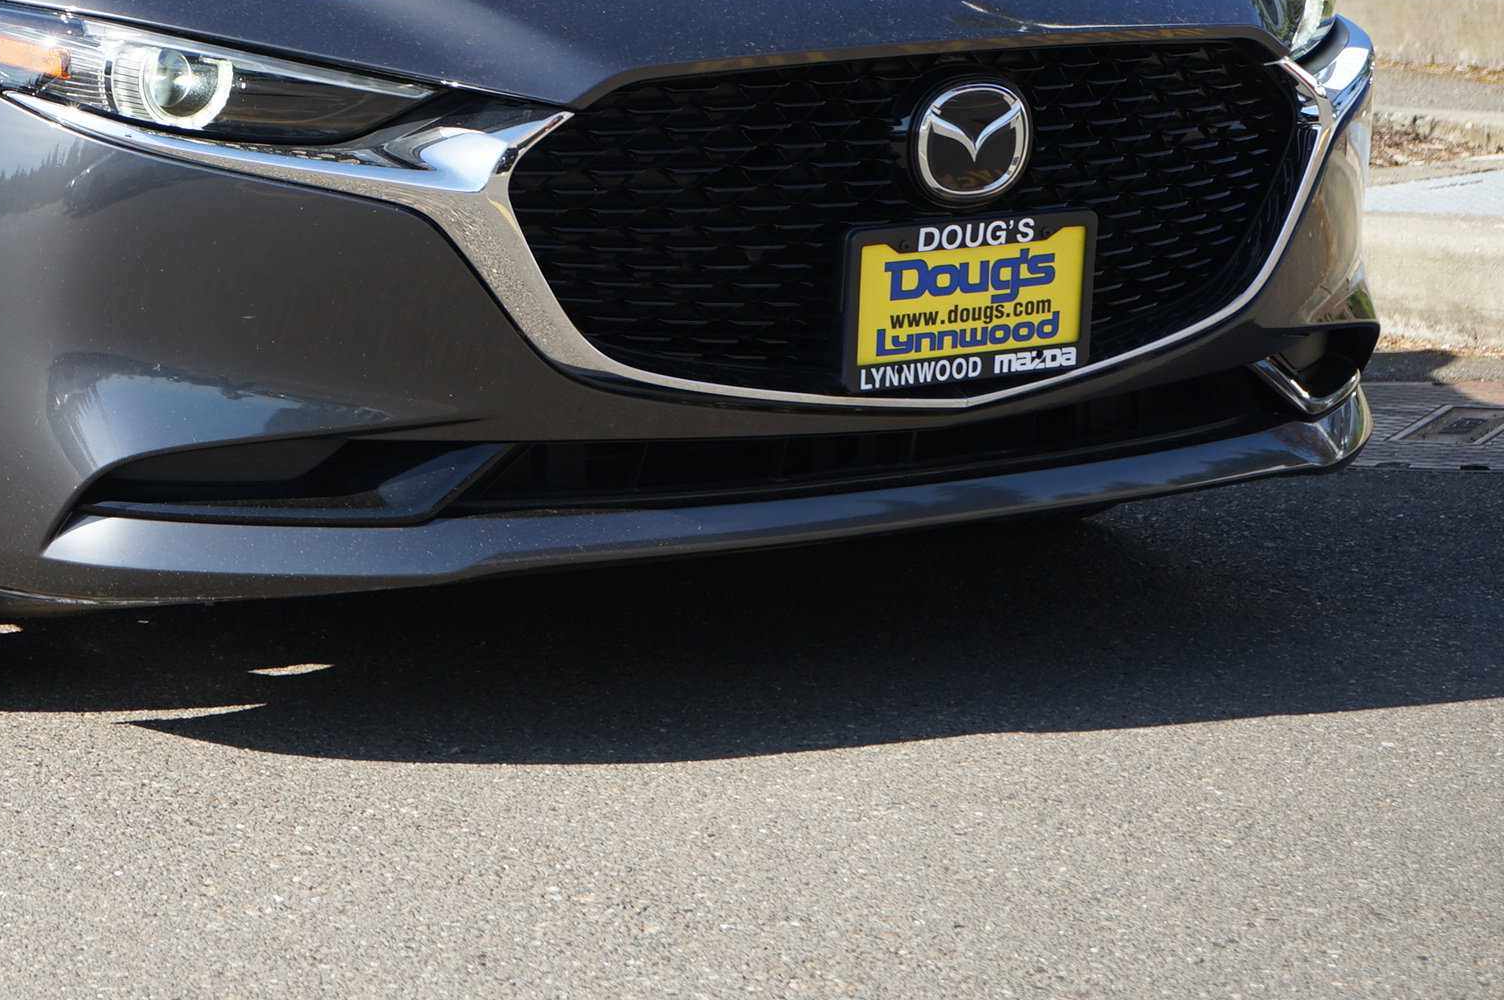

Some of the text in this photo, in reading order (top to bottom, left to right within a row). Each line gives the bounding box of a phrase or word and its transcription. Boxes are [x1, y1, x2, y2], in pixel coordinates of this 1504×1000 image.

[918, 217, 1036, 252] DOUG'S
[884, 248, 1056, 304] Doug's
[890, 298, 1052, 329] www.dougs.com
[876, 311, 1060, 357] Lynnwood
[860, 356, 983, 390] LYNNWOOD
